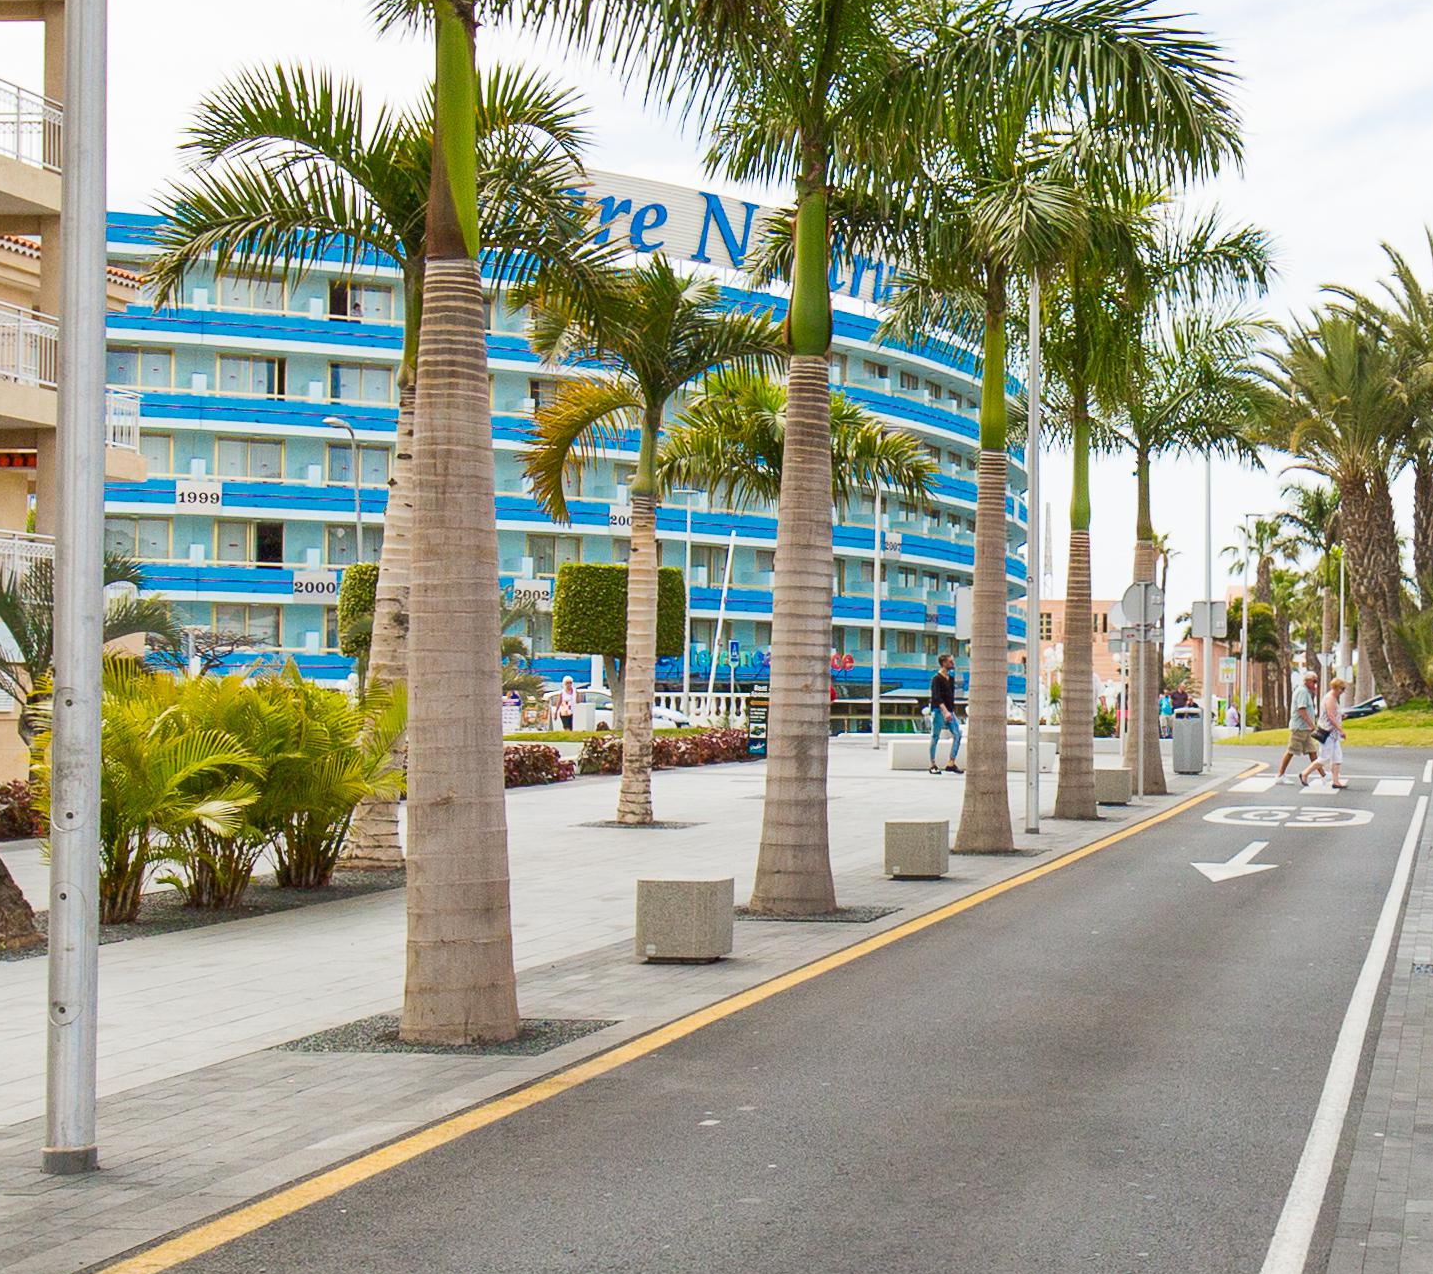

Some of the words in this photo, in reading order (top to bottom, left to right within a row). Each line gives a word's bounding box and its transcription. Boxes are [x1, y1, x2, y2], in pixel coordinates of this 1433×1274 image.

[178, 491, 221, 505] 1999
[609, 514, 632, 527] 200
[294, 581, 336, 594] 2000
[513, 589, 551, 602] 2002
